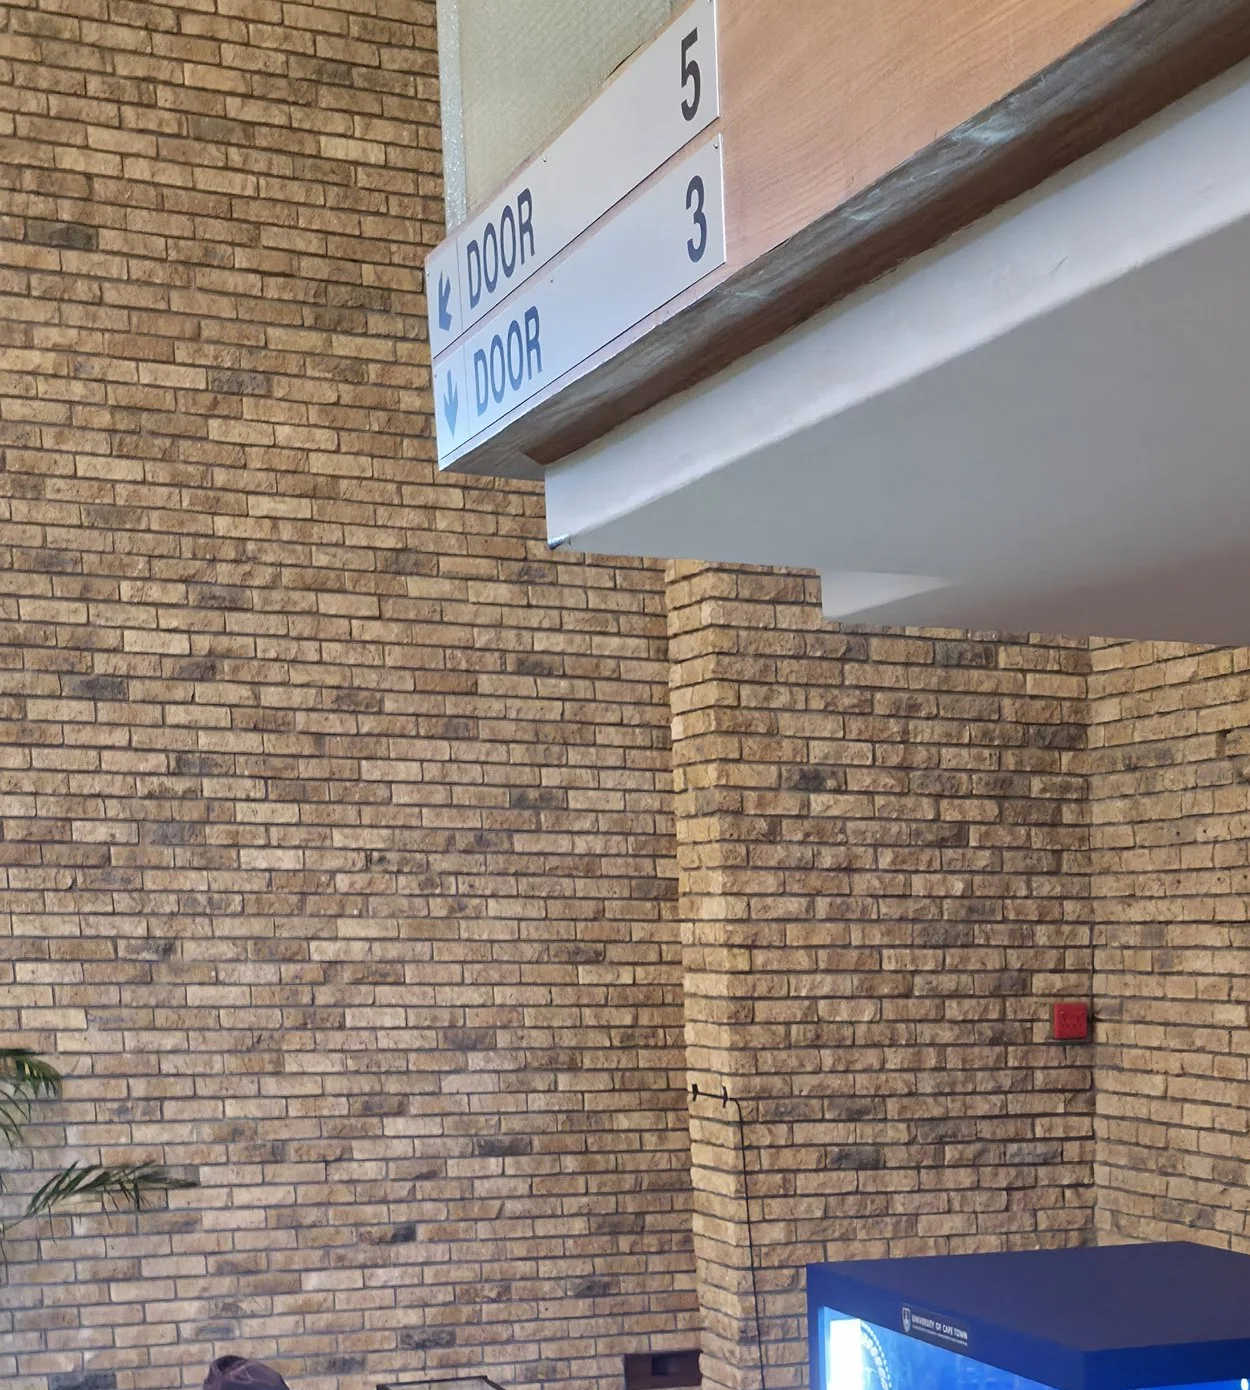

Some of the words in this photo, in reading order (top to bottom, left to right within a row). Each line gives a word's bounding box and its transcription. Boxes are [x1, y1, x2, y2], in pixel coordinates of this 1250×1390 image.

[466, 187, 536, 308] DOOR
[680, 27, 702, 122] 5
[473, 305, 543, 417] DOOR
[685, 175, 708, 263] 3
[935, 1322, 942, 1331] OF
[942, 1324, 954, 1336] CAPE
